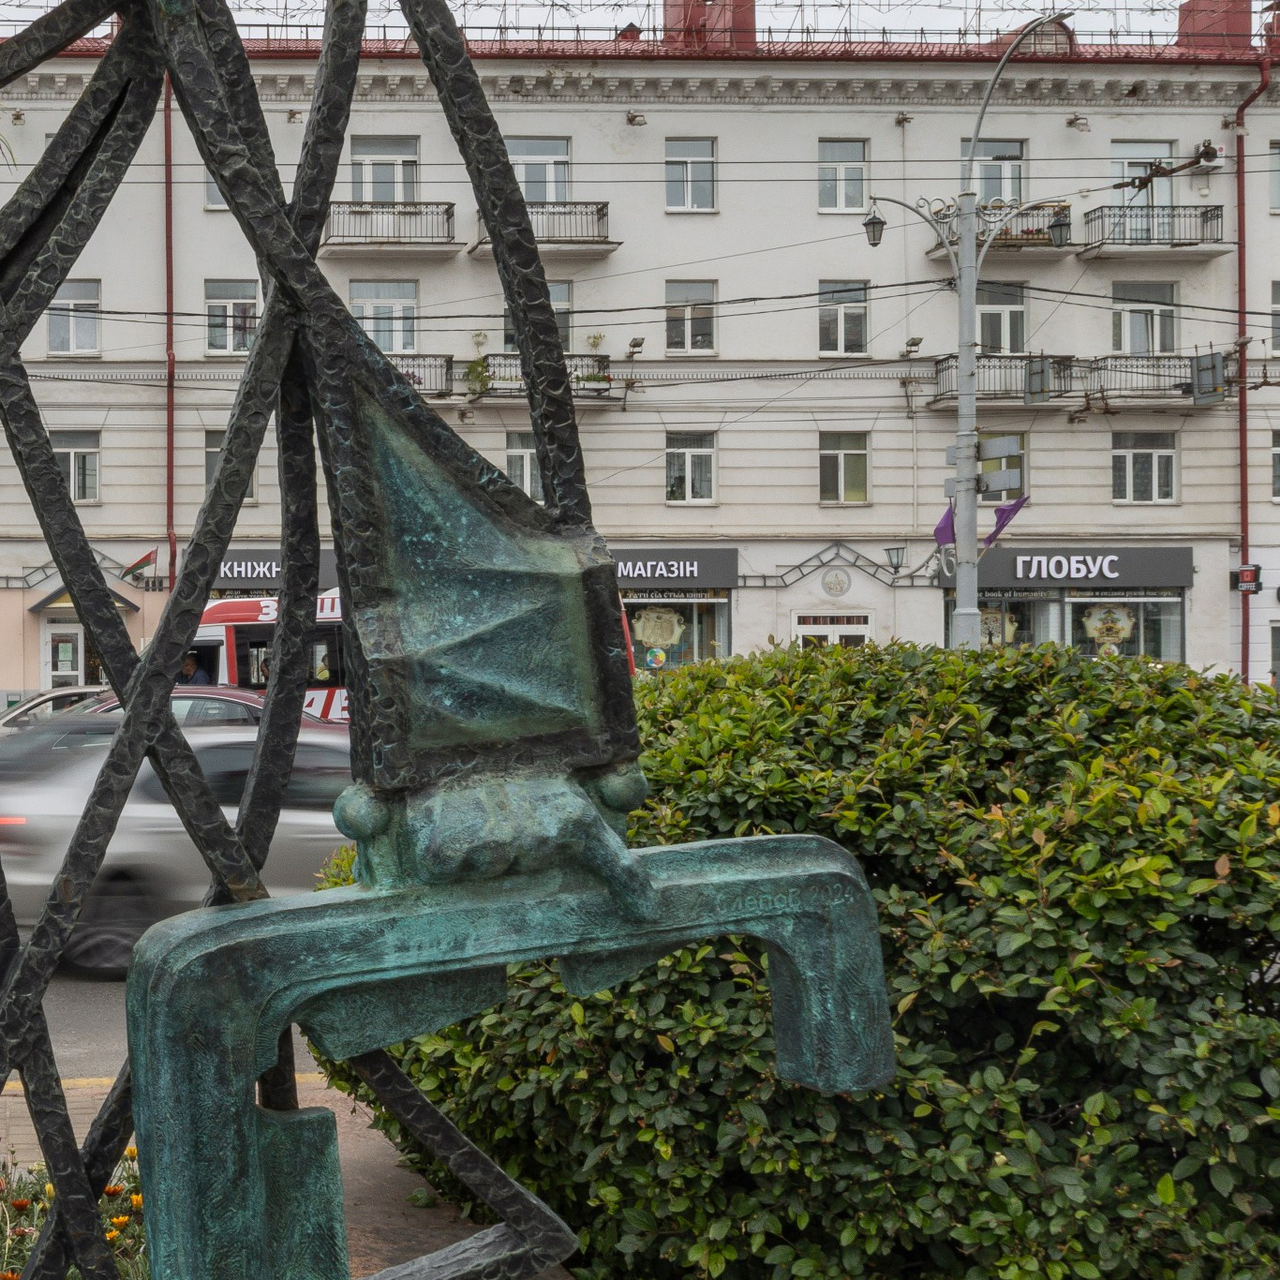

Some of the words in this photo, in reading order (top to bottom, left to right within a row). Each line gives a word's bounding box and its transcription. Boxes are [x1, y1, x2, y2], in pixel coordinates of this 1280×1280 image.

[220, 561, 282, 578] КНІЖН
[617, 561, 698, 578] МАГАЗІН
[1016, 555, 1120, 579] ГЛОБУС
